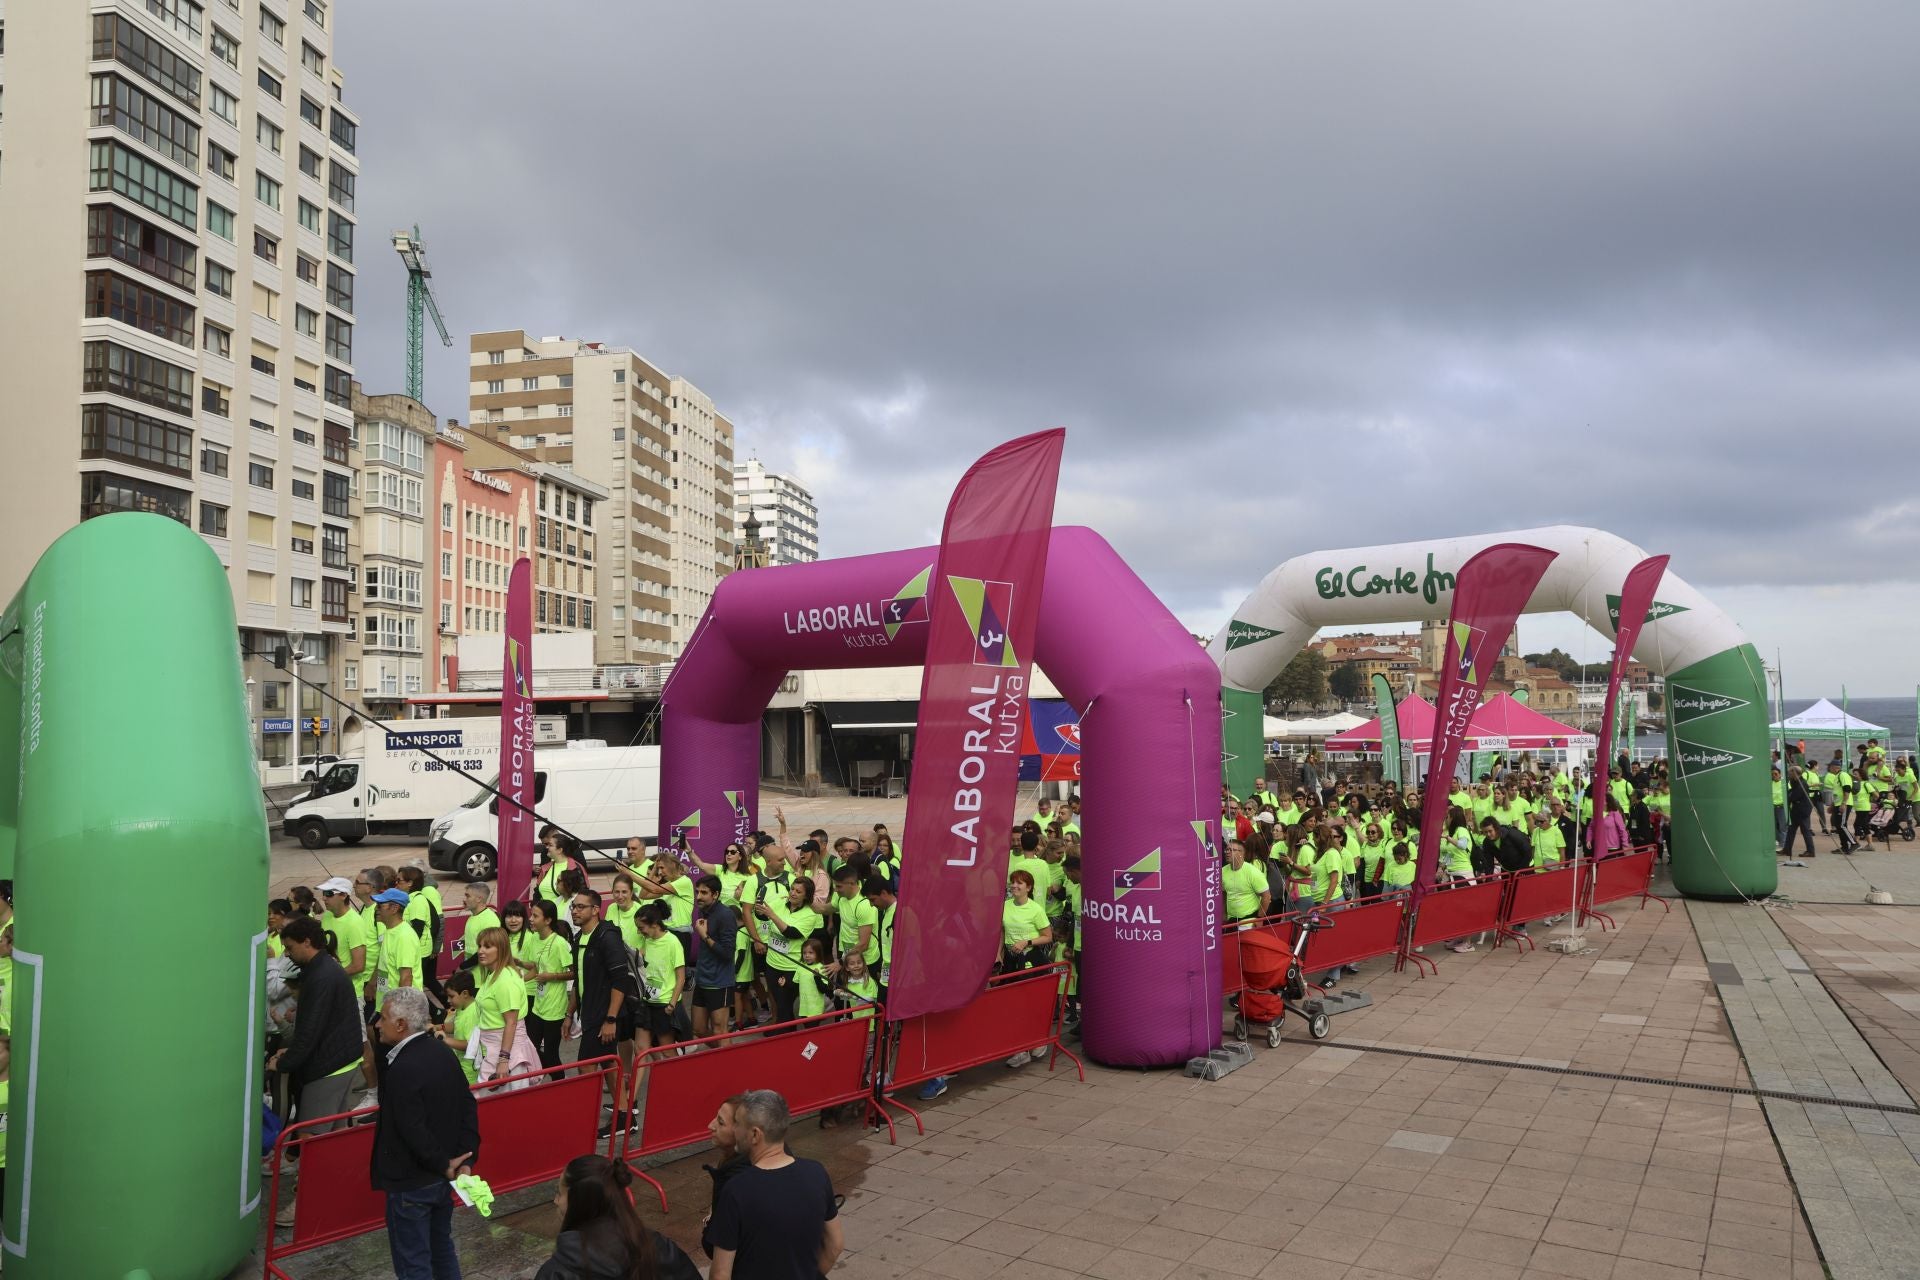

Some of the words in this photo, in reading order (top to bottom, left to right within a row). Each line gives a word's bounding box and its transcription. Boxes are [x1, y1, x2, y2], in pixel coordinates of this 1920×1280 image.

[1316, 567, 1345, 600] El
[1347, 566, 1418, 598] Corte
[784, 602, 880, 634] LABORAL
[843, 632, 889, 648] kutxa
[994, 675, 1024, 754] kutxa
[1452, 688, 1477, 738] kutxa
[1681, 699, 1699, 708] Corte
[1699, 696, 1731, 711] Inglés
[525, 703, 534, 752] kutxa
[424, 760, 443, 772] 985
[463, 759, 483, 770] 333
[446, 747, 500, 756] INMEDIAT
[512, 701, 524, 823] LABORAL
[1683, 753, 1701, 762] Corte
[1701, 750, 1733, 765] Inglés
[946, 675, 1000, 867] LABORAL
[380, 789, 410, 800] Miranda
[1081, 898, 1162, 924] ABORAL
[1206, 861, 1216, 951] LABORAL
[1115, 926, 1162, 941] kutxa
